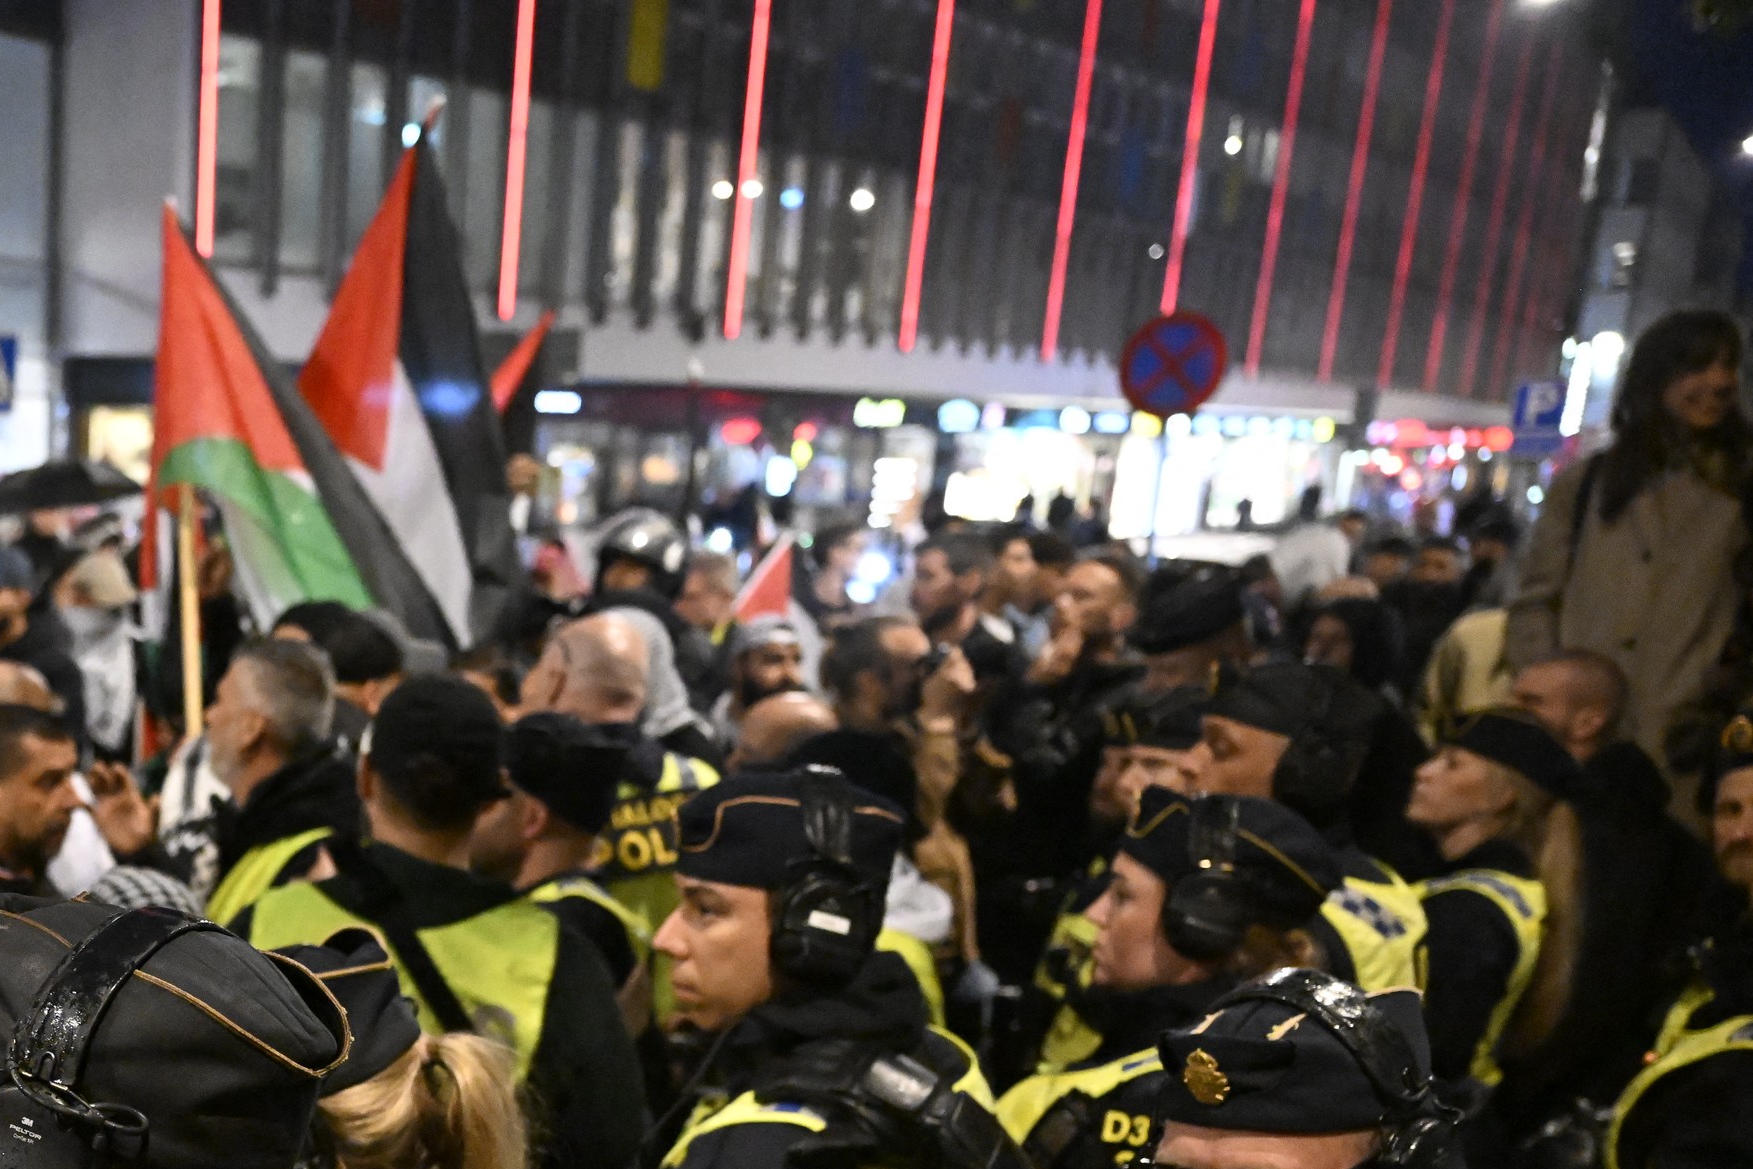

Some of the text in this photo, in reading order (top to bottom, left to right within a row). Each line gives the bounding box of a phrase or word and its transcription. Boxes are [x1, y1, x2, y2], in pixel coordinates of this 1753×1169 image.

[1527, 383, 1558, 424] P
[21, 1117, 34, 1127] 3M
[9, 1123, 42, 1140] PELTOR
